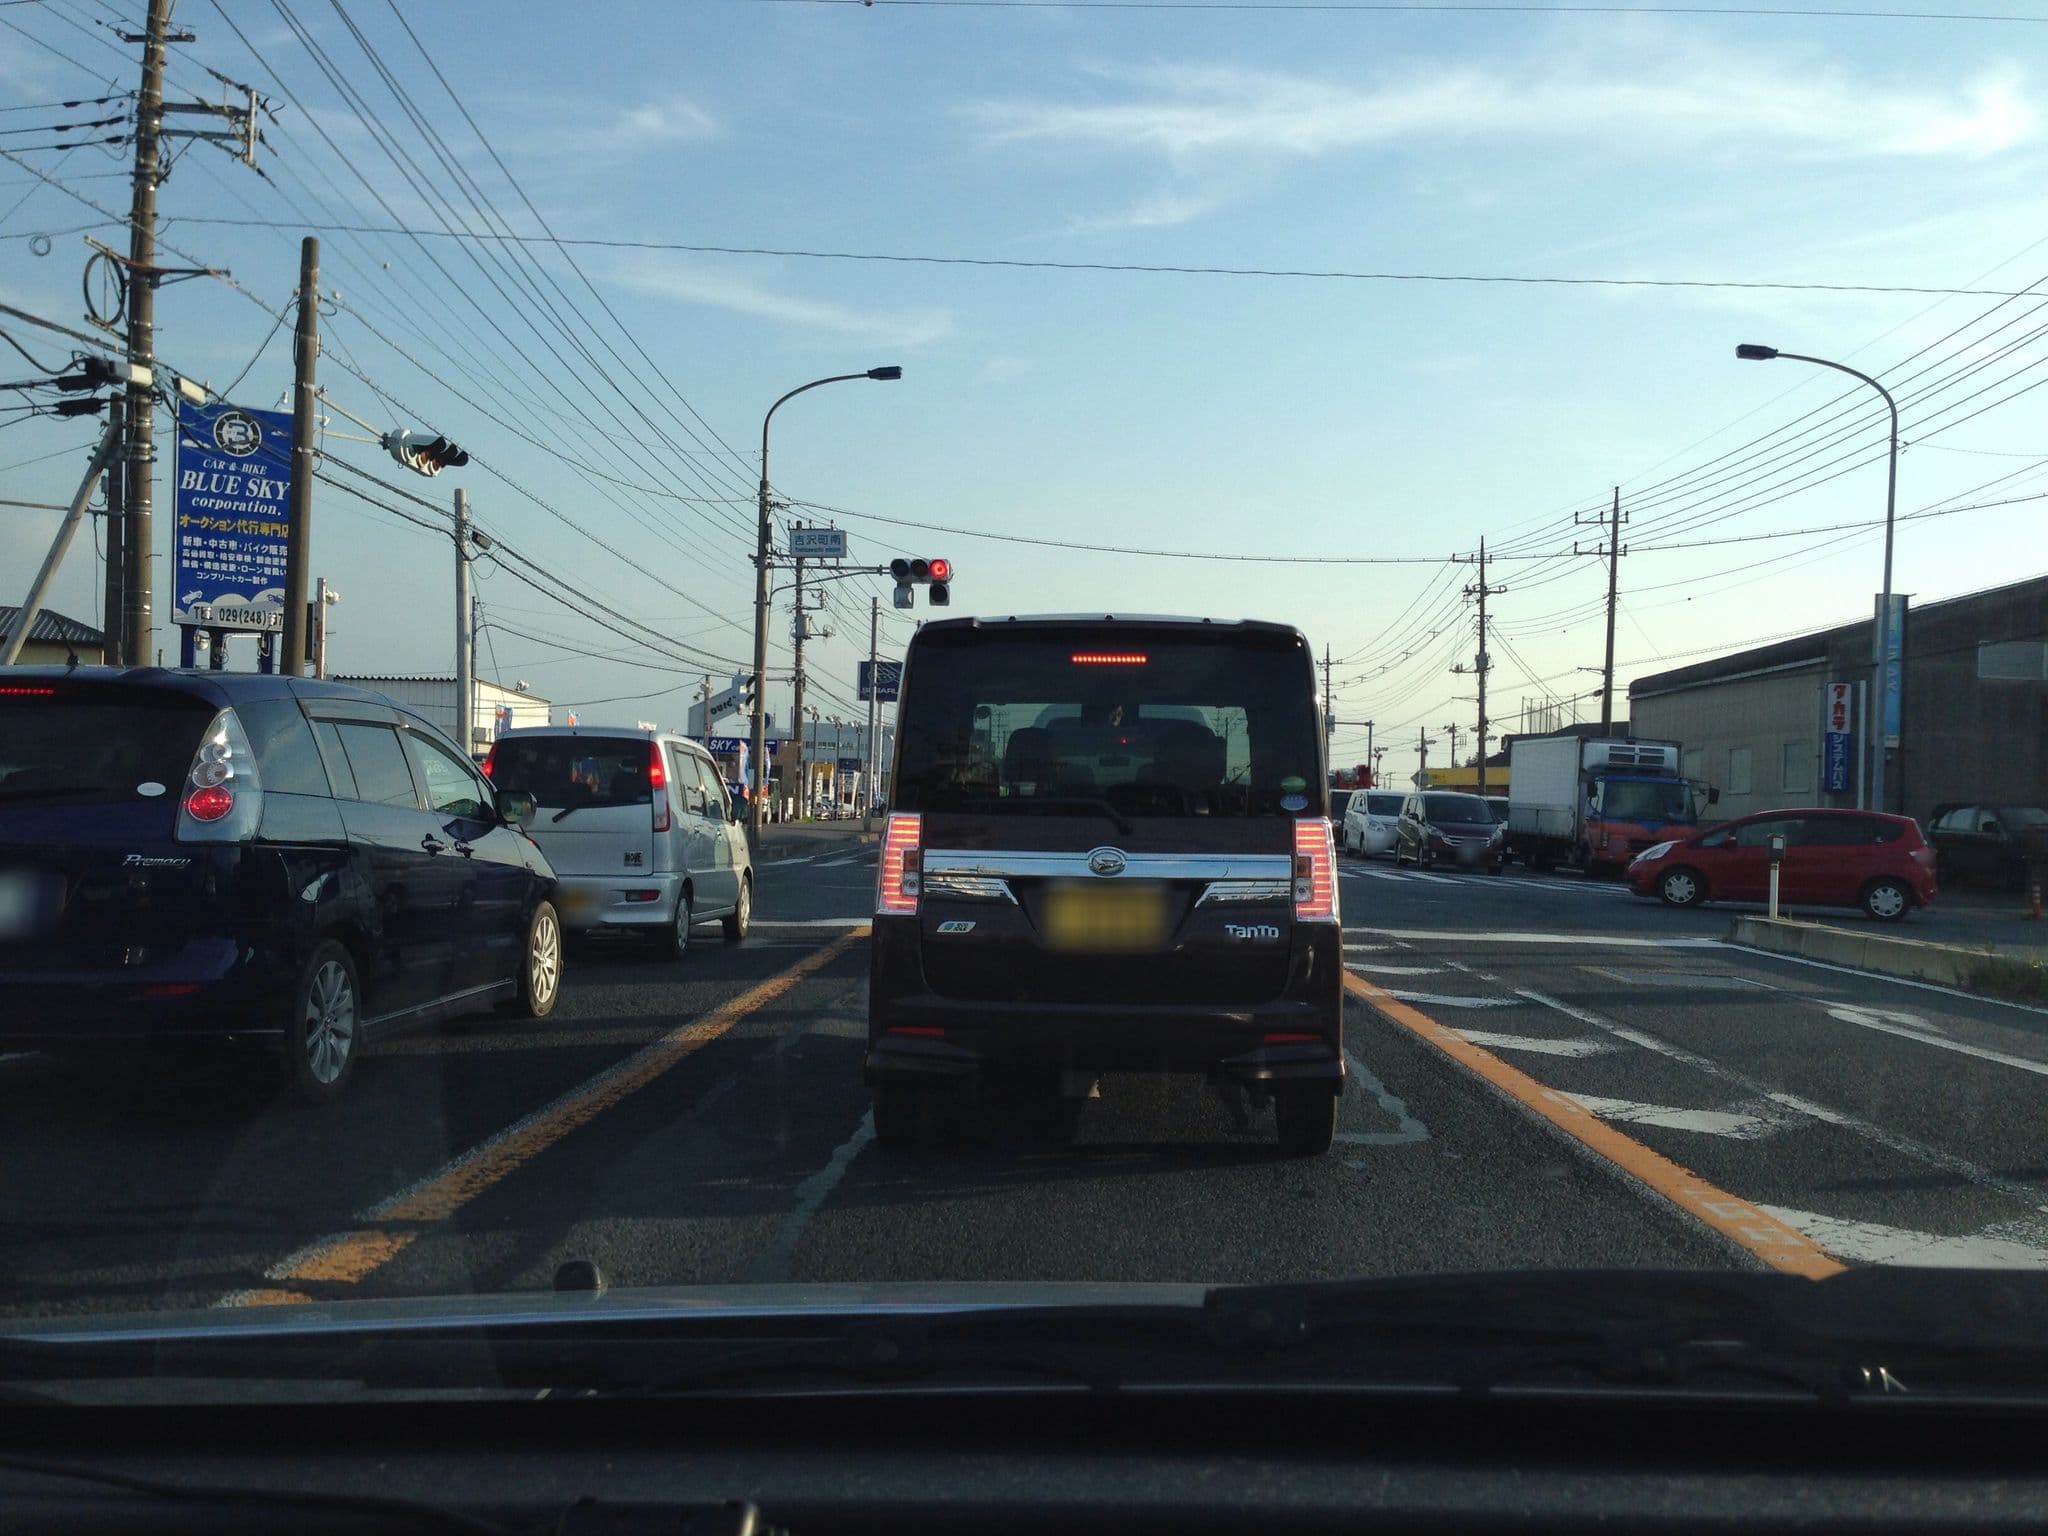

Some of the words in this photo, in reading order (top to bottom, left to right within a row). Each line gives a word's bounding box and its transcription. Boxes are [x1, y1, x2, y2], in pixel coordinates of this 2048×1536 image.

[203, 459, 224, 470] CAR
[229, 462, 237, 471] &
[242, 464, 267, 475] BIKE
[180, 470, 241, 495] BLUE
[246, 478, 290, 500] SKY
[192, 497, 281, 516] corporation.
[1832, 684, 1846, 730] タカラ
[709, 740, 732, 750] SKY
[1832, 734, 1844, 790] システムバス
